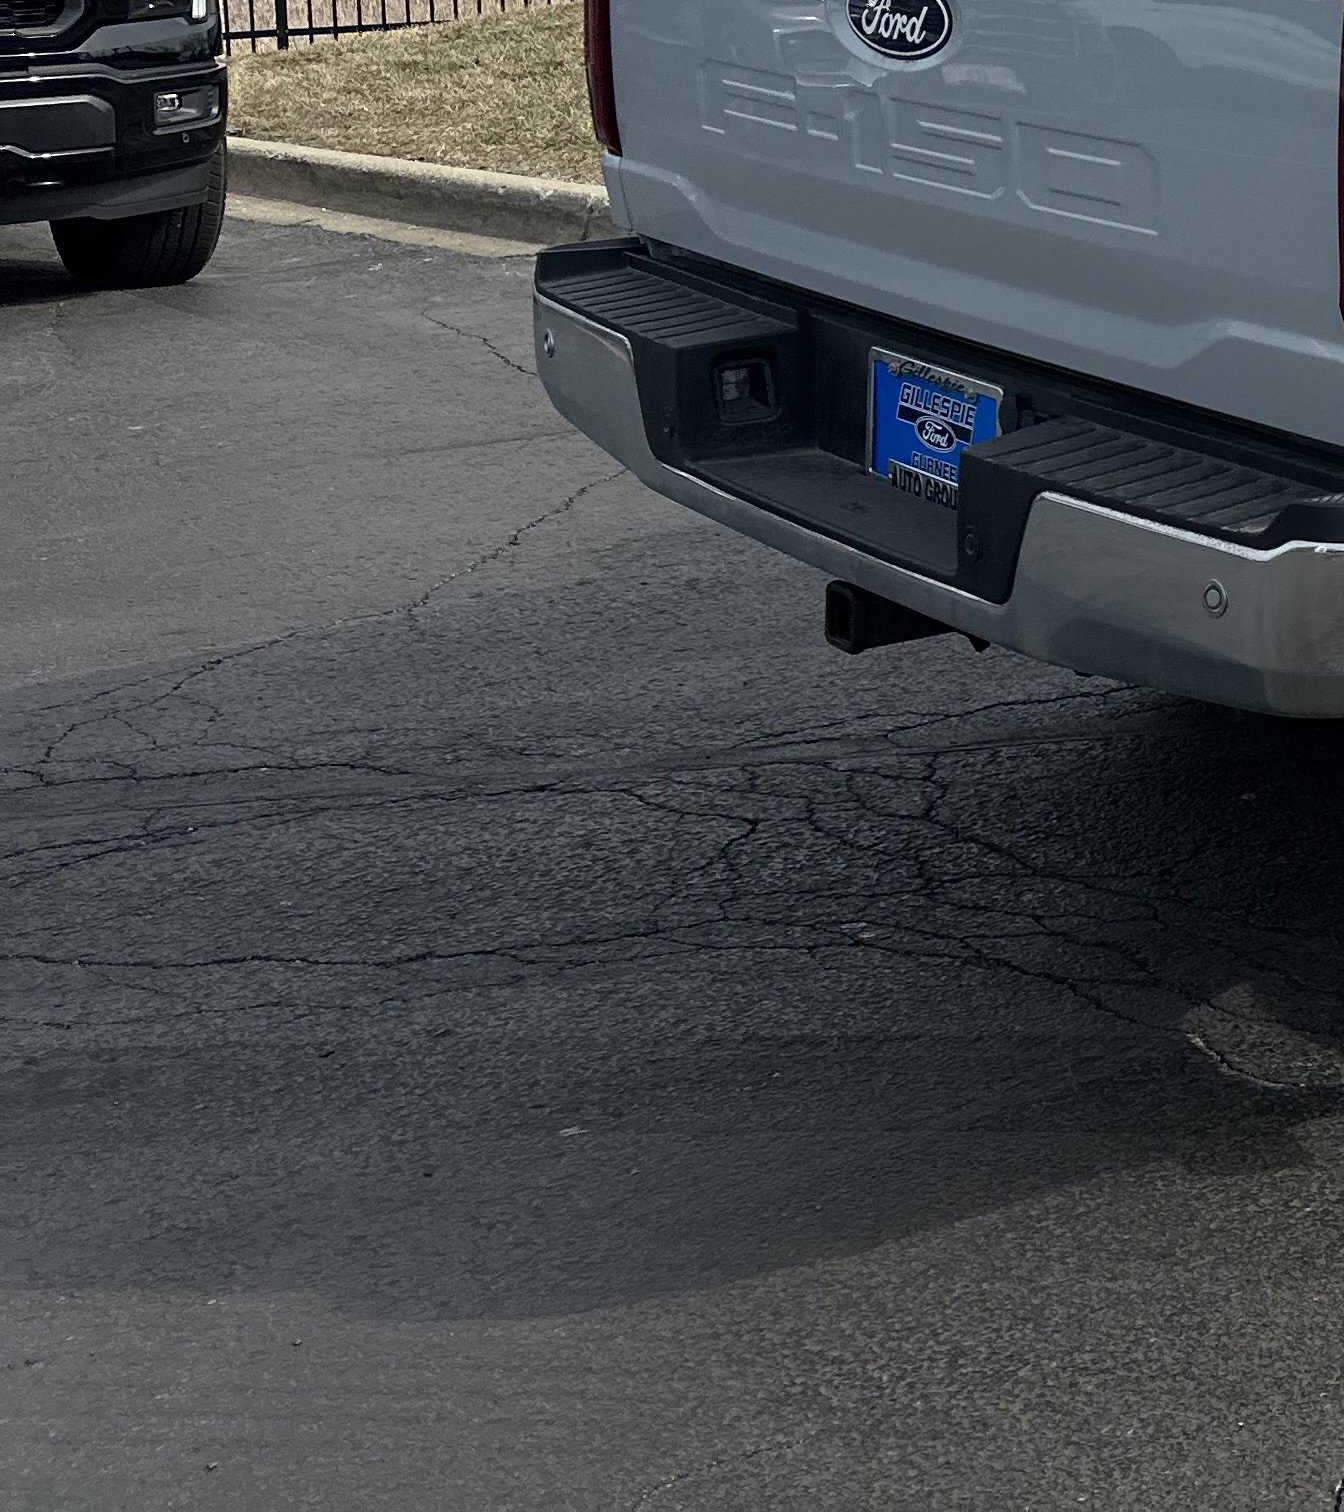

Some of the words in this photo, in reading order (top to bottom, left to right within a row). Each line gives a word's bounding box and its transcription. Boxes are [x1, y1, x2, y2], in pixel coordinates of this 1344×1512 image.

[701, 59, 1162, 237] F-150
[900, 361, 967, 393] Gillespie
[900, 382, 978, 427] GILLESPIE
[922, 420, 949, 448] Ford
[891, 464, 923, 498] AUTO
[911, 450, 959, 482] GURNEE
